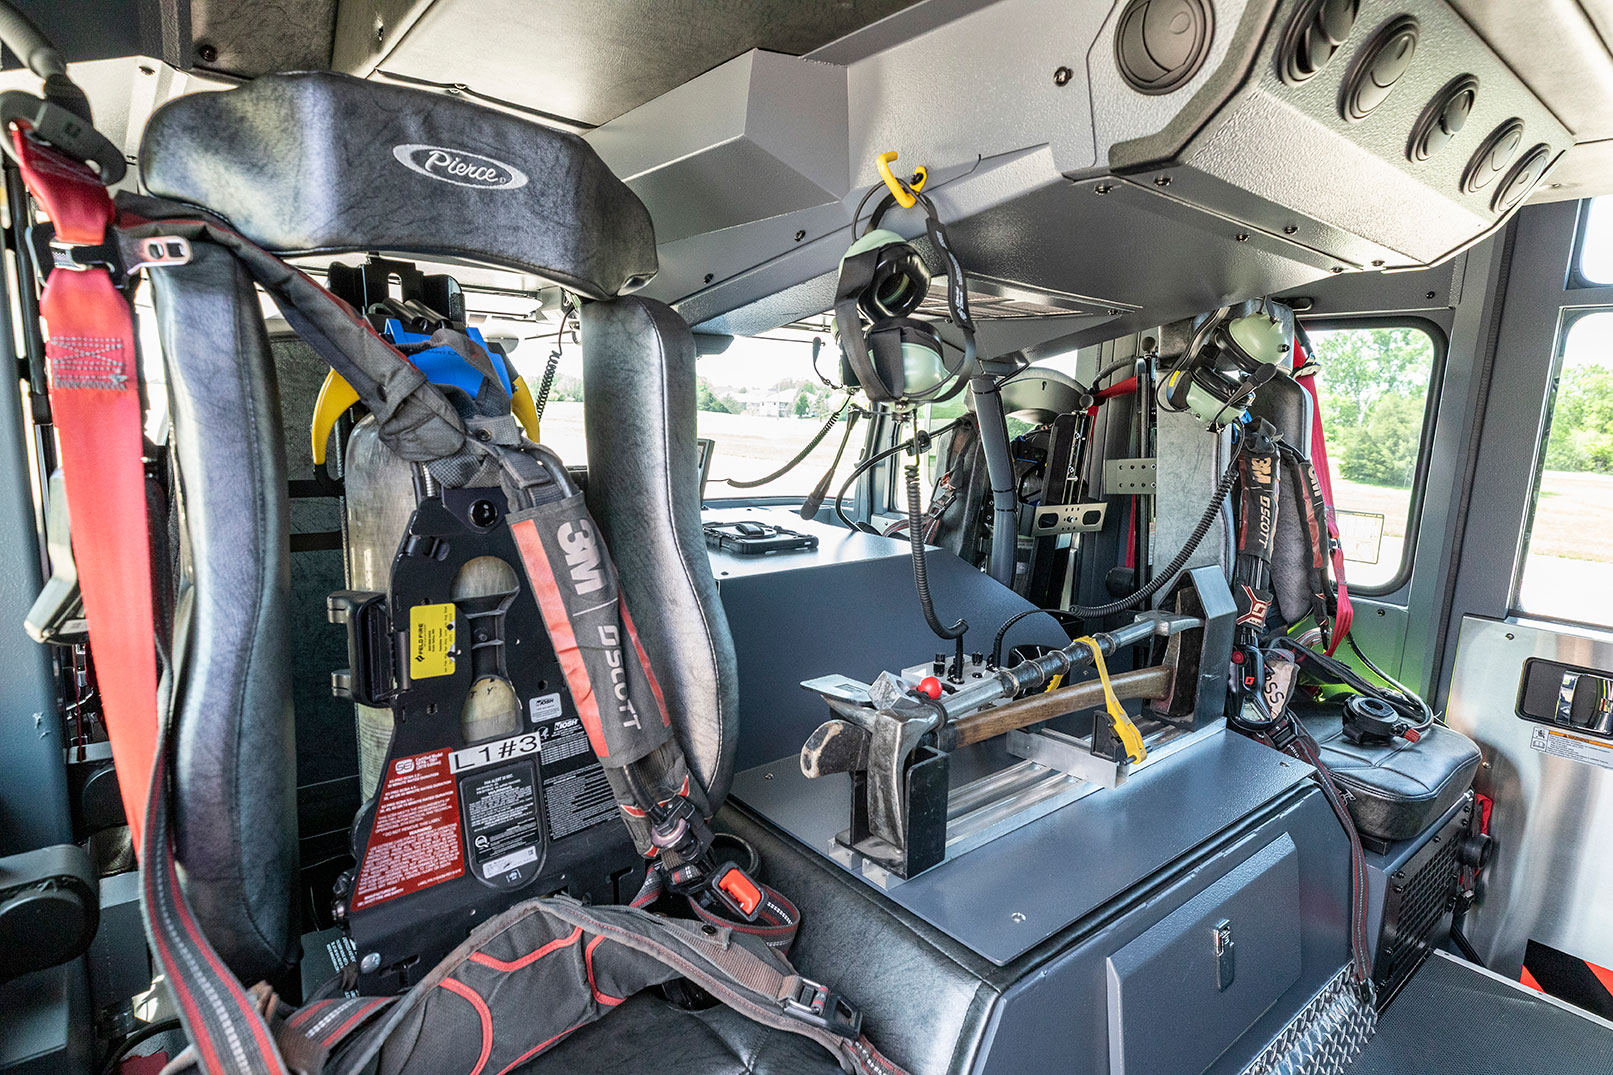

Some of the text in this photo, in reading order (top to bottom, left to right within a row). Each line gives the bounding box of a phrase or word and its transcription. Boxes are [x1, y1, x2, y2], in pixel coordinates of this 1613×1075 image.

[425, 150, 498, 182] Pierce
[1252, 457, 1272, 484] 3M
[1258, 510, 1270, 548] SCOTT
[557, 519, 606, 595] 3M
[605, 650, 641, 729] SCOTT
[554, 718, 579, 730] NIOSH
